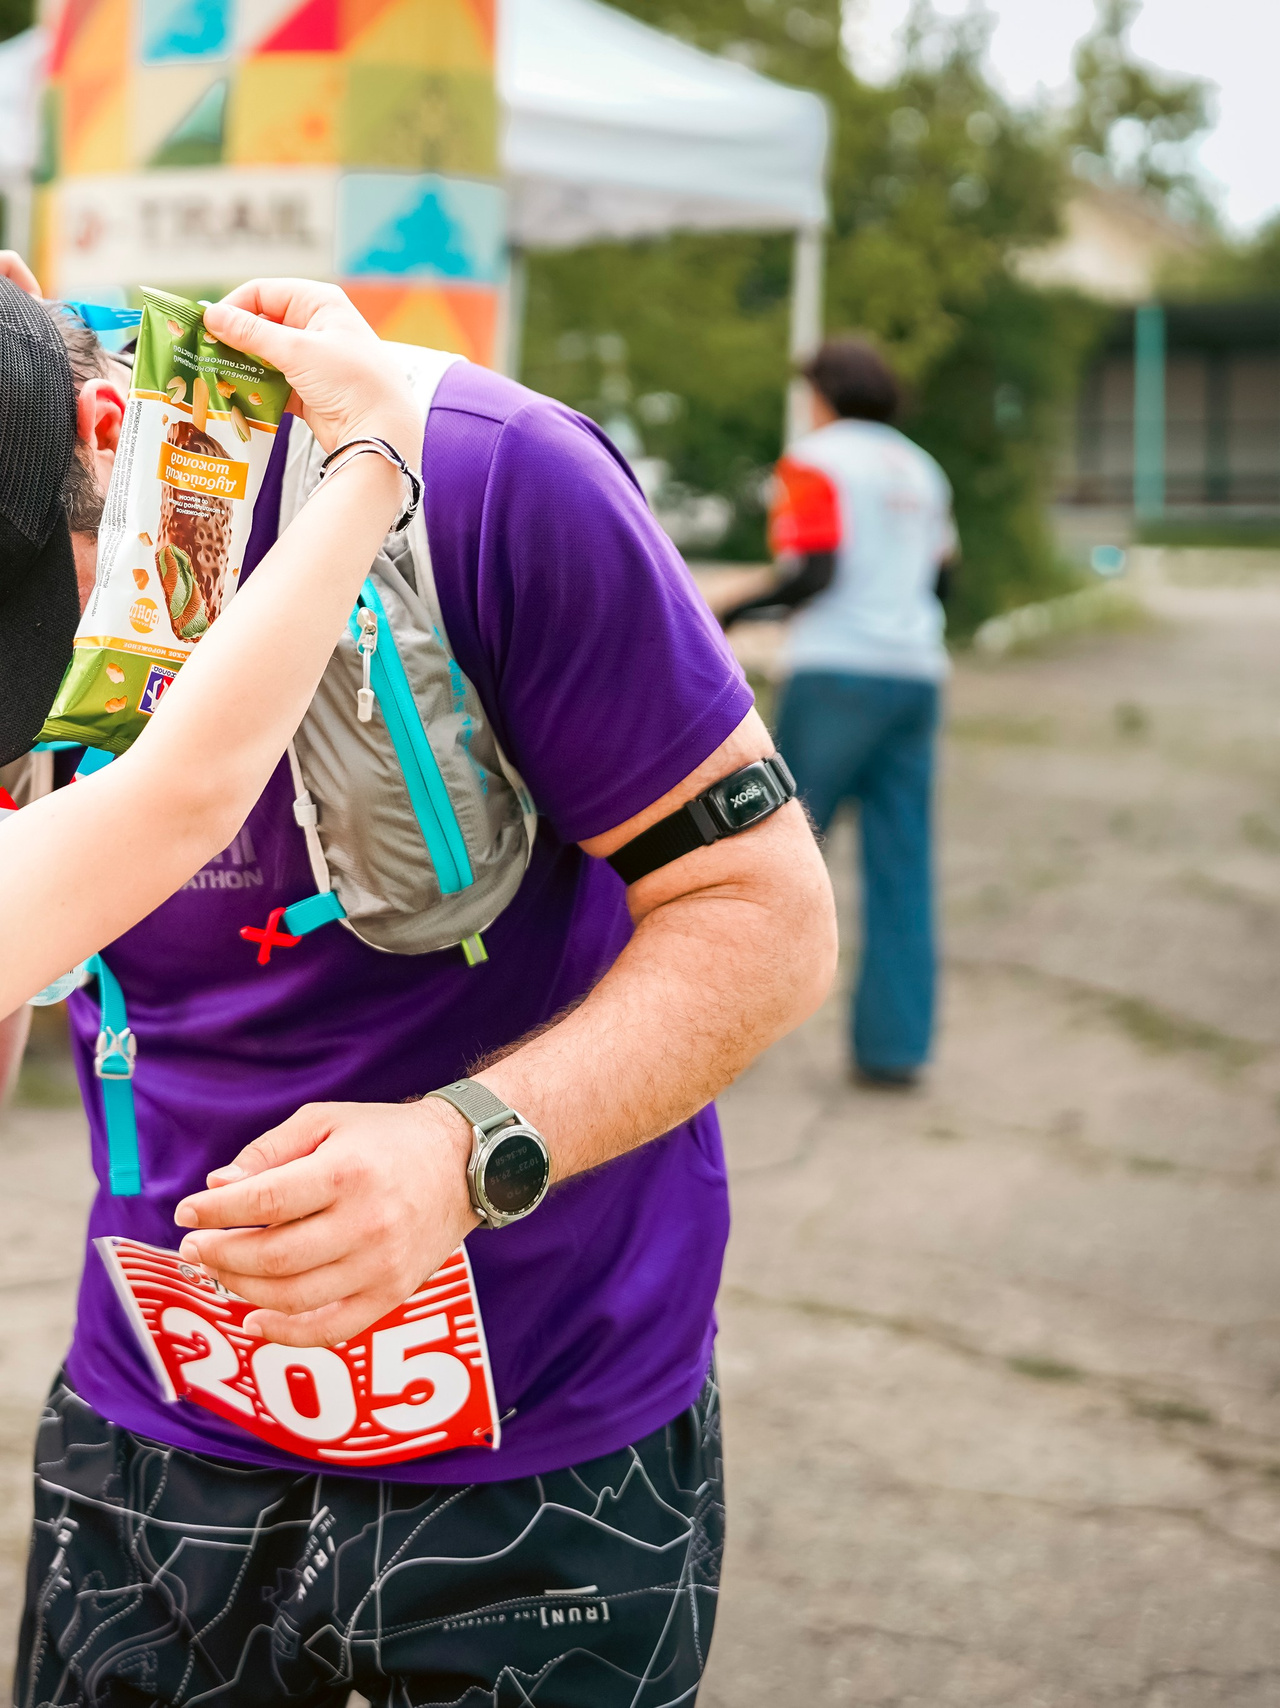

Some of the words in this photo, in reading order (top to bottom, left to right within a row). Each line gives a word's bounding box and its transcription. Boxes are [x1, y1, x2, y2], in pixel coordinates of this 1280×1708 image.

[173, 345, 194, 359] ПАСТОЙ
[194, 355, 258, 373] ФИСТАШКОВОЙ
[220, 369, 260, 384] ПЛОМБИР
[170, 452, 230, 475] шоколад
[165, 465, 237, 493] Дубайский
[729, 785, 762, 808] XOSS
[161, 1307, 471, 1443] 205
